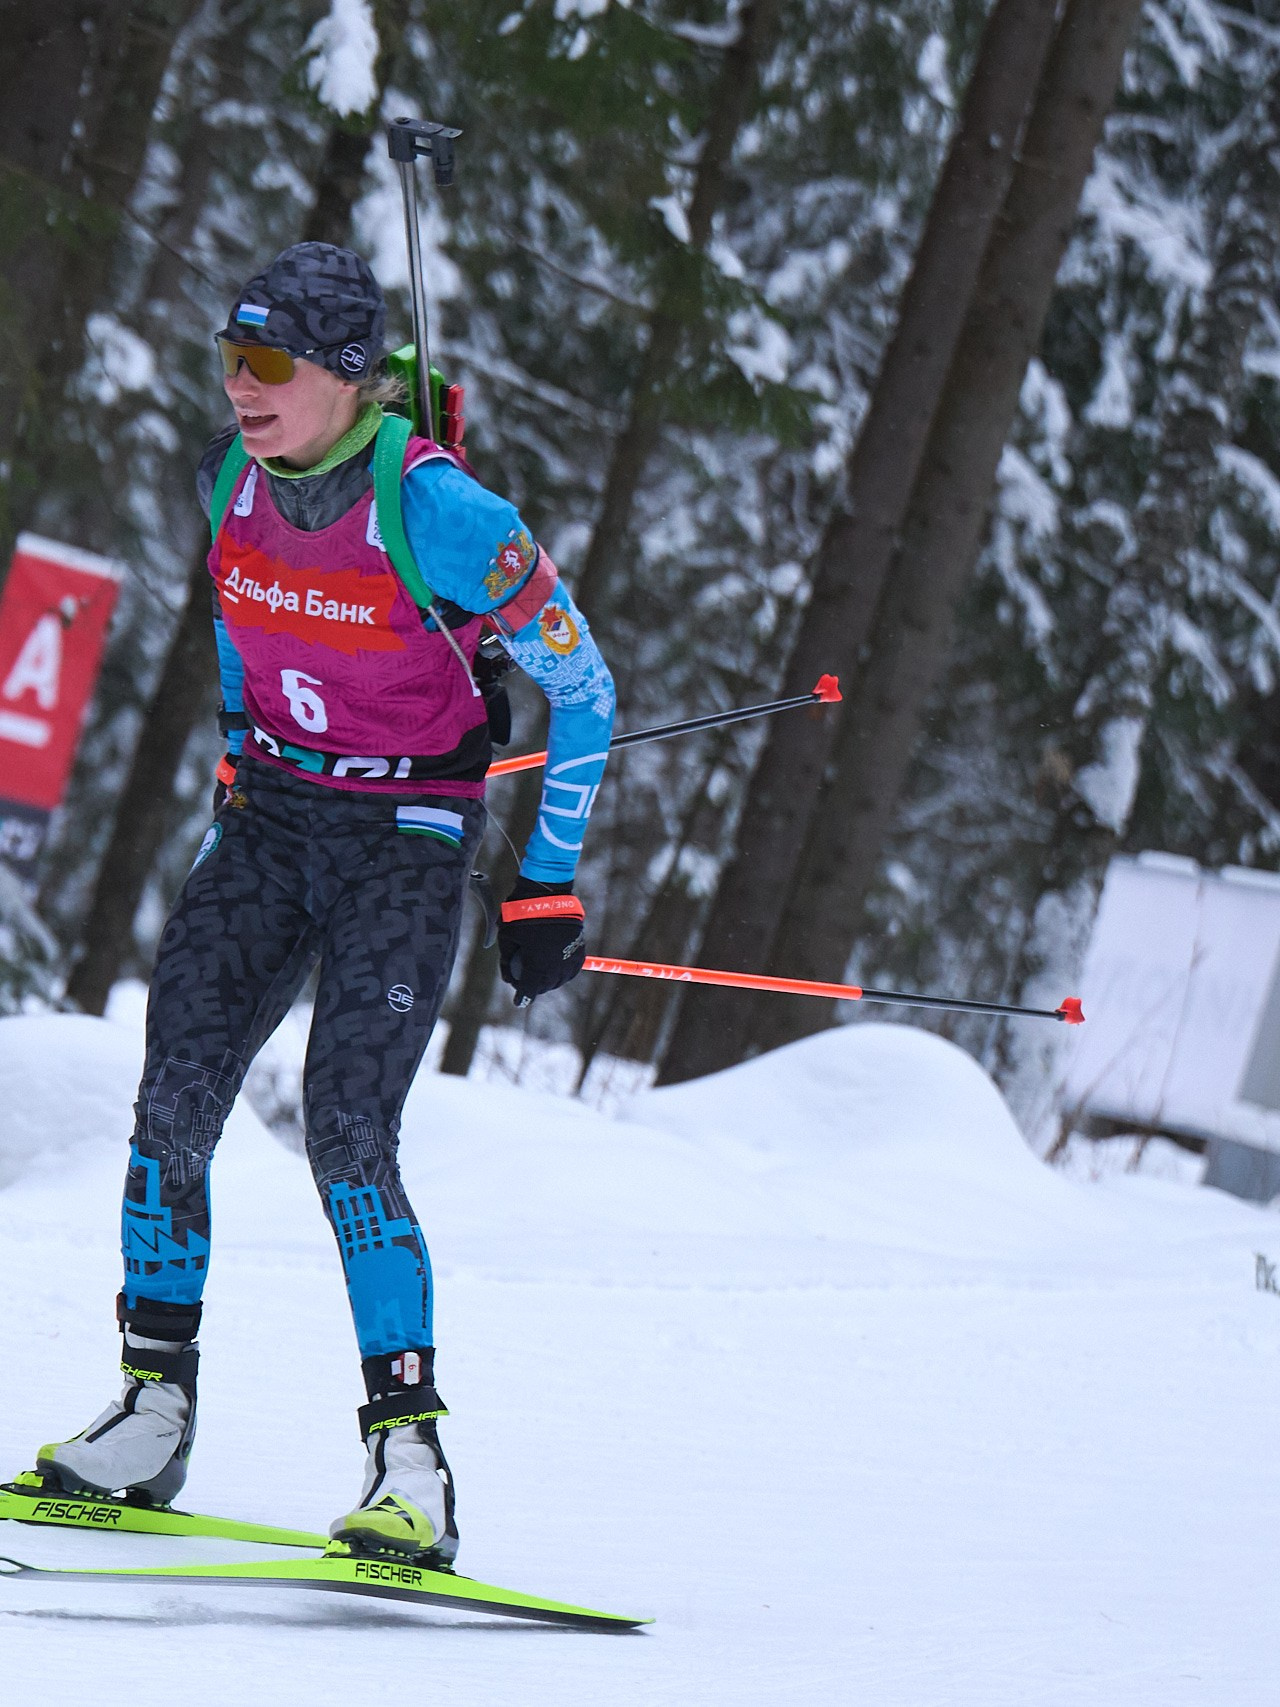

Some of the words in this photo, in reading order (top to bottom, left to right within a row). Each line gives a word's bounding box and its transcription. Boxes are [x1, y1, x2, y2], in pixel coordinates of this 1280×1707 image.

[224, 567, 300, 613] Альфа
[305, 589, 376, 625] Банк
[280, 669, 328, 734] 6
[120, 1361, 163, 1382] CHER
[32, 1502, 122, 1525] FISCHER
[355, 1562, 422, 1586] FISCHER
